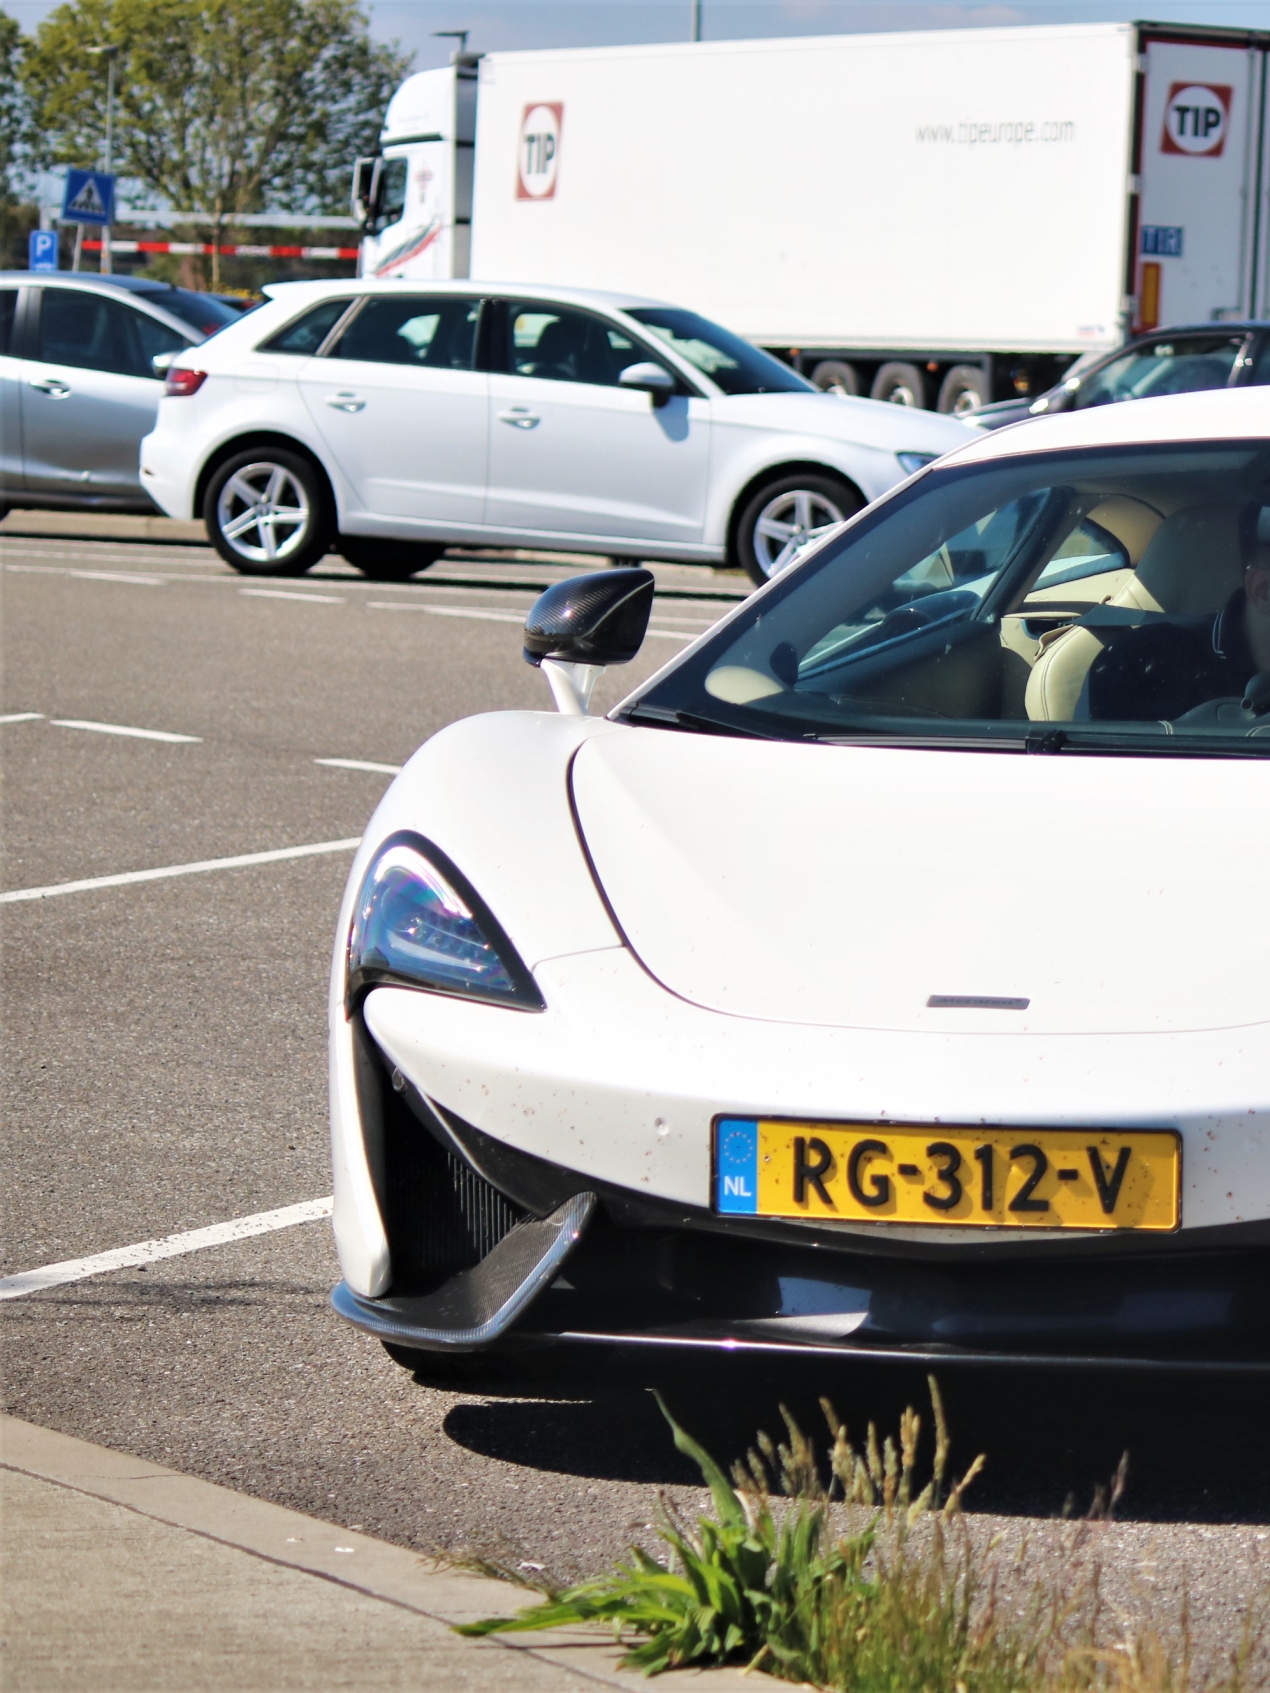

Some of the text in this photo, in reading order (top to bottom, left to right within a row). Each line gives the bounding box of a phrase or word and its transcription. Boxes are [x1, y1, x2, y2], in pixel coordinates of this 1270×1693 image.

[1173, 105, 1222, 138] TIP
[523, 132, 556, 175] TIP
[36, 234, 52, 257] P
[1144, 228, 1180, 253] TIR
[724, 1176, 752, 1198] NL
[792, 1136, 1132, 1214] RG-312-V
